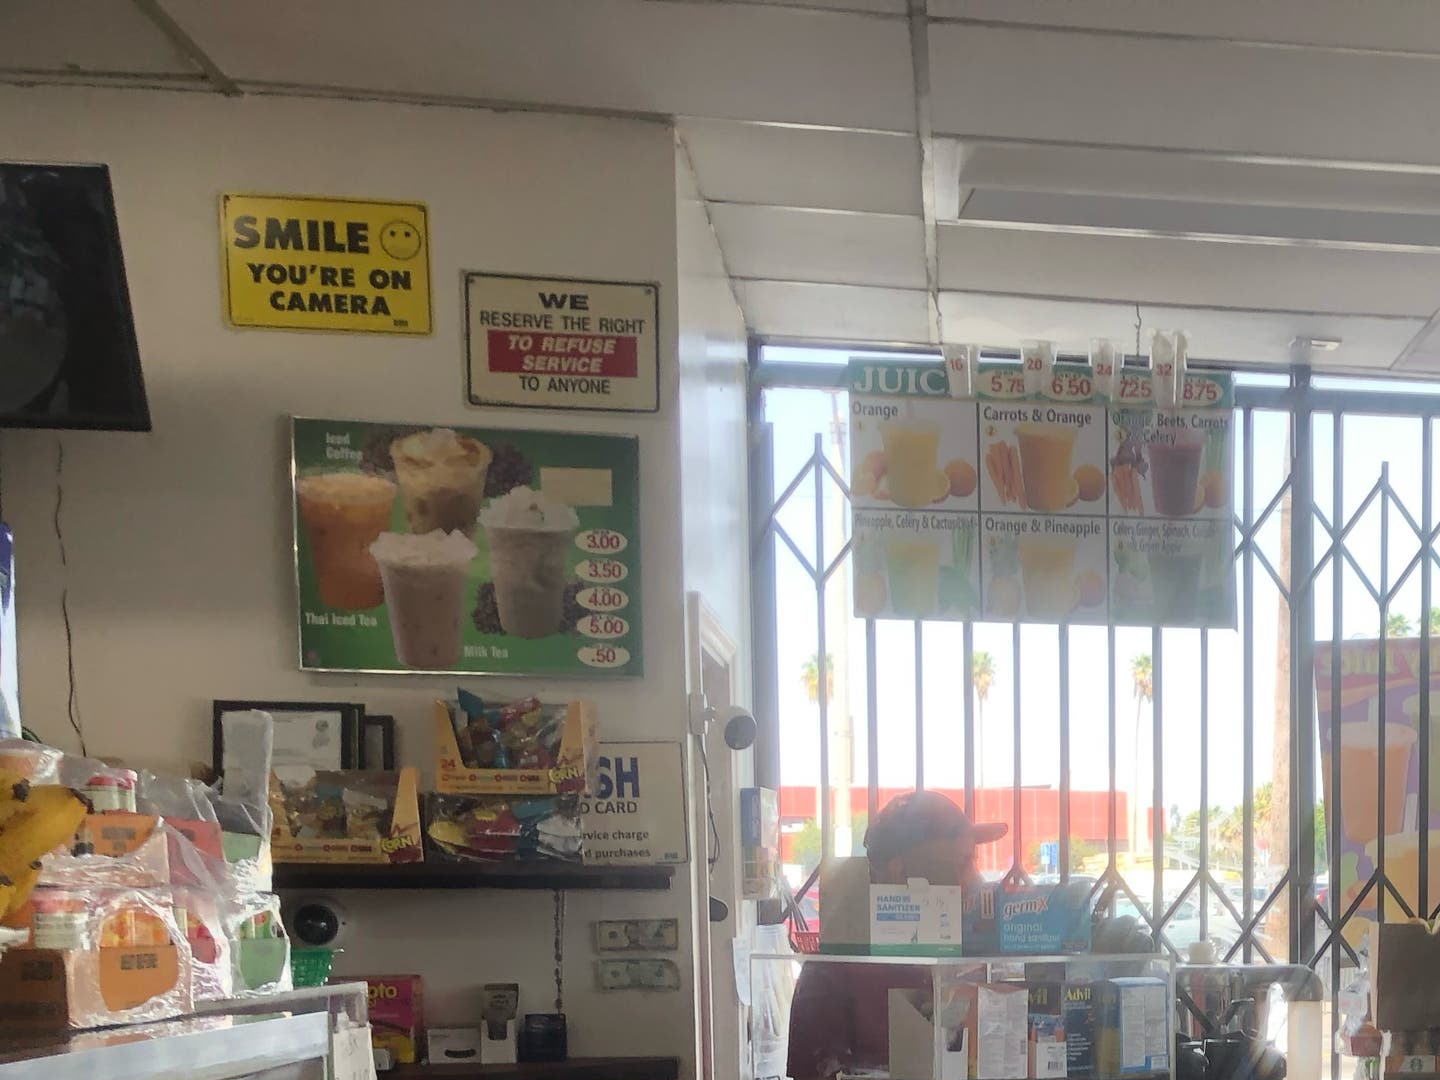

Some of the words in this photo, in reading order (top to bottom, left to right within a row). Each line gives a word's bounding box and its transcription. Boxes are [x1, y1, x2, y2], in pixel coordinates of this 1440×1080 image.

[233, 215, 369, 254] SMILE
[247, 262, 355, 289] YOU'RE
[369, 268, 411, 291] ON
[269, 291, 390, 316] CAMERA
[538, 292, 589, 311] WE
[480, 311, 552, 330] RESERVE
[561, 316, 591, 331] THE
[599, 317, 646, 335] RIGHT
[508, 335, 533, 351] TO
[541, 337, 615, 354] REFUSE
[522, 354, 602, 373] SERVICE
[1156, 363, 1172, 377] 32
[519, 375, 540, 392] TO
[547, 377, 610, 395] ANYONE
[852, 365, 948, 394] JUIC
[852, 402, 899, 421] Orange
[983, 406, 1028, 422] Carrots
[1032, 410, 1045, 422] &
[1047, 409, 1092, 427] Orange
[985, 518, 1028, 535] Orange
[1031, 520, 1041, 533] &
[1045, 521, 1101, 538] Pineapple
[587, 534, 620, 549] 3.00
[588, 562, 622, 578] 3.50
[588, 592, 622, 607] 4.00
[590, 618, 624, 634] 5.00
[591, 648, 616, 663] .50
[595, 801, 638, 814] CARD
[583, 829, 609, 841] rvice
[612, 830, 649, 846] charge
[595, 848, 651, 860] purchases
[1065, 987, 1091, 1001] Advil
